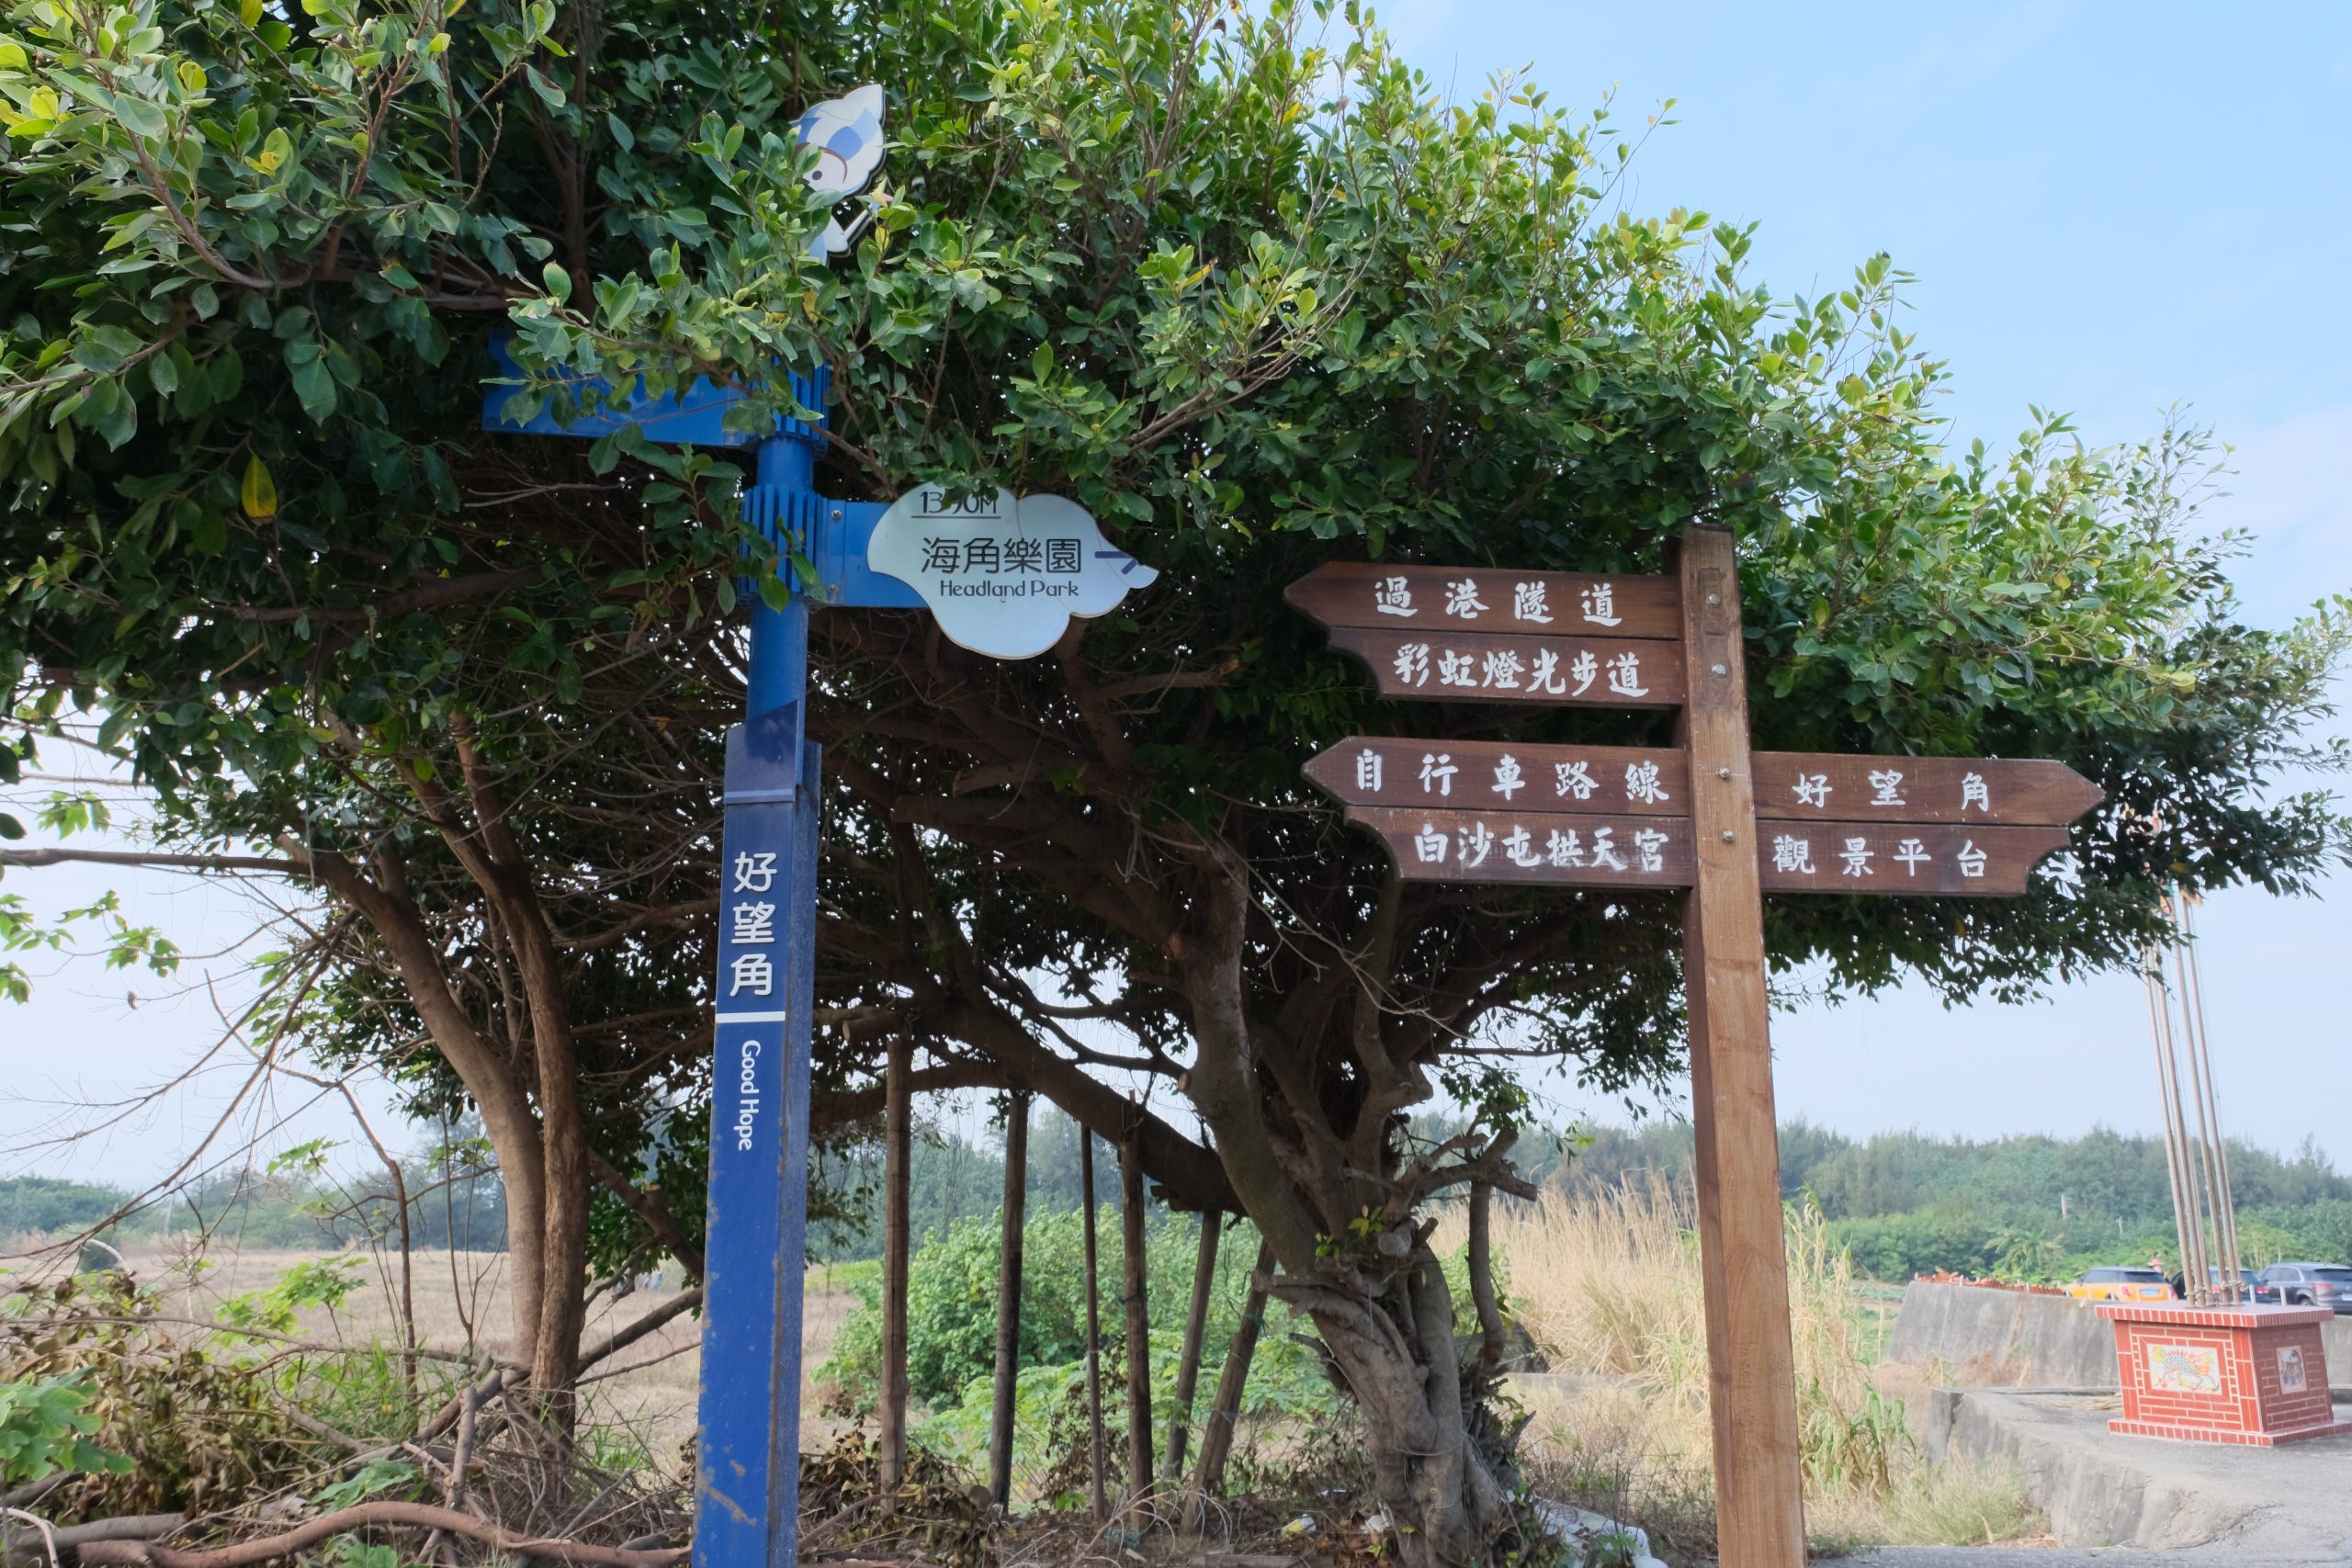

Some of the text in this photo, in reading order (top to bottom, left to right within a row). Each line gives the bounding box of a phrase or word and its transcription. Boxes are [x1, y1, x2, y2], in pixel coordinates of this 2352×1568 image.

[921, 537, 1081, 575] 海角樂園
[940, 580, 1080, 597] Headland Park
[1374, 575, 1623, 627] 過港隧道
[1392, 643, 1650, 698] 彩虹燈光步道
[1356, 749, 1669, 805] 自行車路線
[1792, 769, 1989, 812] 好望角
[1414, 821, 1669, 872] 白沙屯拱天宮
[1771, 834, 1987, 878] 觀景平台
[729, 851, 777, 997] 好望角
[733, 1040, 762, 1152] Good Hope
